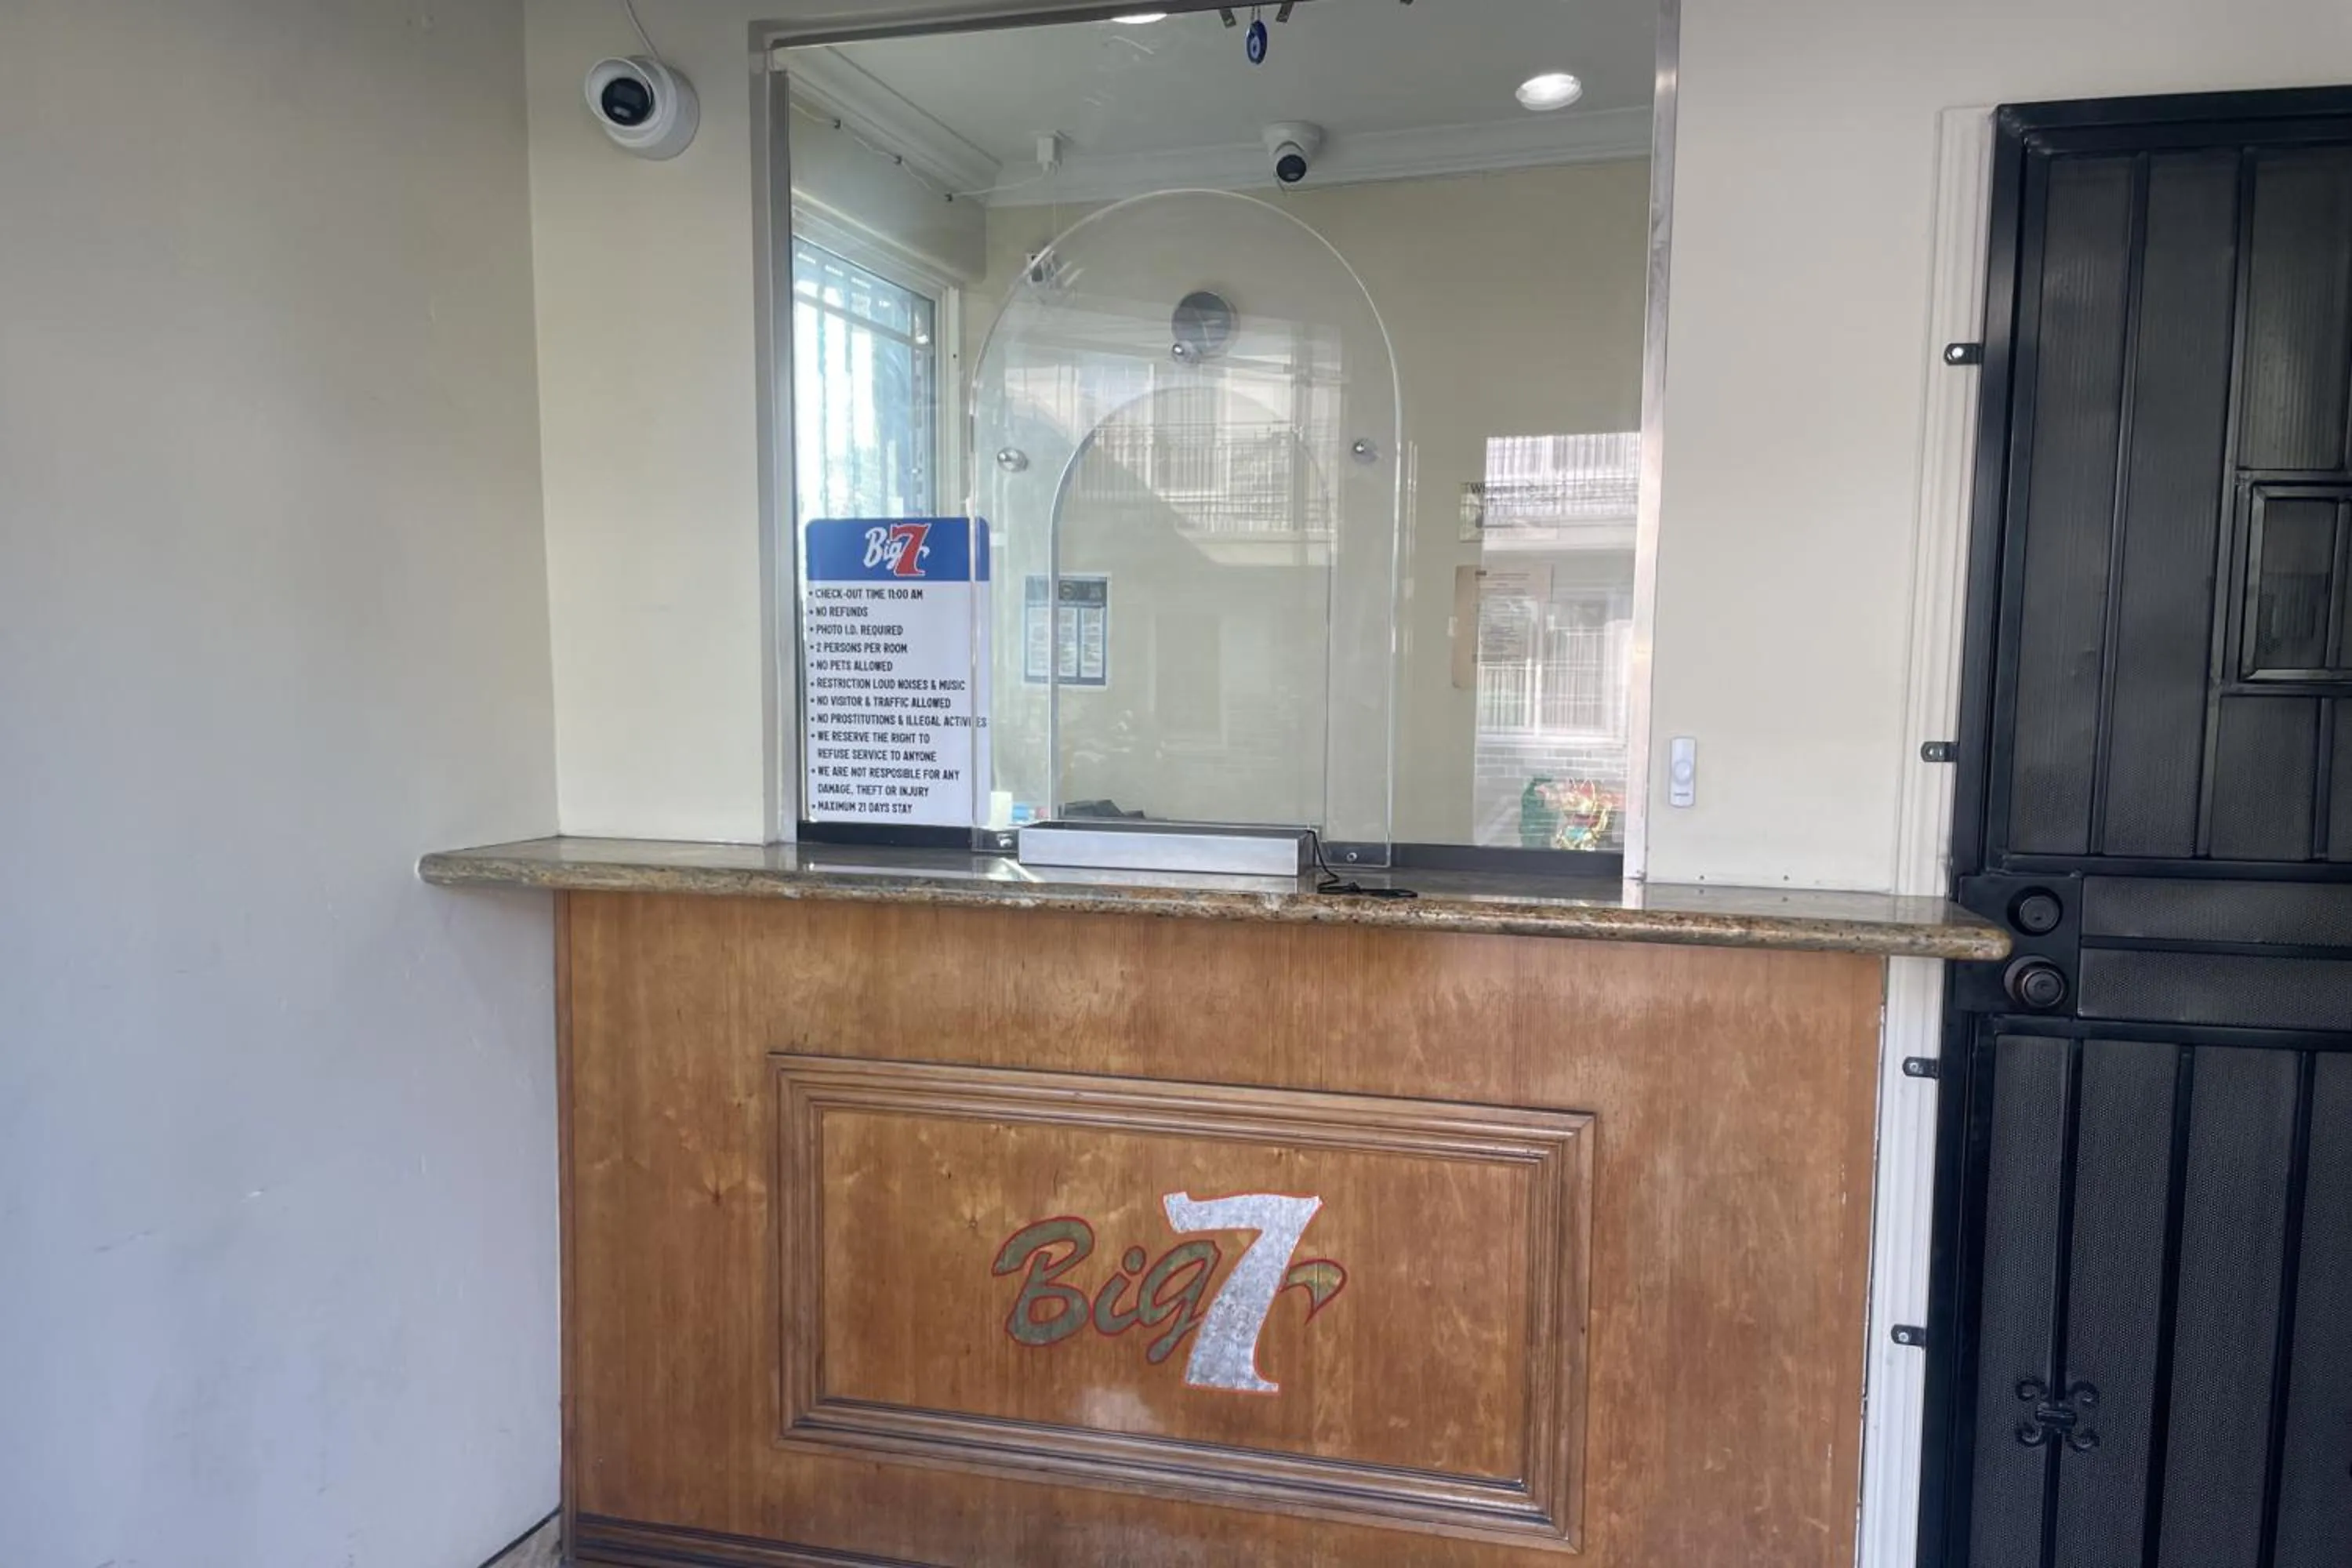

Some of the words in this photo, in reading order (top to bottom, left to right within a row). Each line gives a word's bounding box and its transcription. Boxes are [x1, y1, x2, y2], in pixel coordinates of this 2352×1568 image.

[863, 526, 902, 570] Big
[890, 523, 932, 577] 7
[815, 589, 862, 599] CHECK-OUT
[865, 589, 885, 599] TIME
[910, 589, 924, 600] AM
[816, 606, 827, 617] NO
[829, 606, 869, 617] REFUNDS
[816, 624, 843, 634] PHOTO
[860, 625, 904, 636] REQUIRED
[816, 642, 822, 653] 2
[823, 642, 862, 653] PERSONS
[863, 642, 882, 653] PER
[883, 642, 908, 654] ROOM
[816, 660, 828, 670] NO
[829, 660, 851, 670] PETS
[853, 661, 893, 672] ALLOWED
[816, 677, 871, 688] RESTRICTION
[873, 679, 895, 689] LOUD
[898, 679, 929, 690] NOISES
[931, 680, 937, 690] &
[938, 680, 965, 691] MUSIC
[817, 696, 829, 706] NO
[830, 696, 863, 706] VISITOR
[865, 696, 871, 707] &
[873, 697, 909, 707] TRAFFIC
[911, 697, 951, 709] ALLOWED
[817, 713, 829, 724] NO
[830, 713, 895, 725] PROSTITUTIONS
[898, 715, 904, 726] &
[906, 715, 941, 727] ILLEGAL
[818, 731, 830, 741] WE
[831, 731, 869, 742] RESERVE
[872, 732, 889, 742] THE
[891, 733, 916, 743] RIGHT
[918, 733, 930, 744] TO
[818, 749, 851, 760] REFUSE
[852, 749, 888, 760] SERVICE
[891, 750, 902, 761] TO
[903, 751, 937, 762] ANYONE
[818, 767, 831, 776] WE
[832, 767, 849, 777] ARE
[851, 768, 867, 778] NOT
[923, 769, 941, 779] FOR
[942, 770, 960, 781] ANY
[856, 785, 884, 796] THEFT
[885, 786, 898, 796] OR
[899, 786, 929, 797] INJURY
[818, 801, 857, 811] MAXIMUM
[858, 802, 867, 813] 21
[868, 802, 891, 813] DAYS
[891, 803, 913, 814] STAY
[992, 1215, 1223, 1366] Big
[1162, 1190, 1323, 1396] 7
